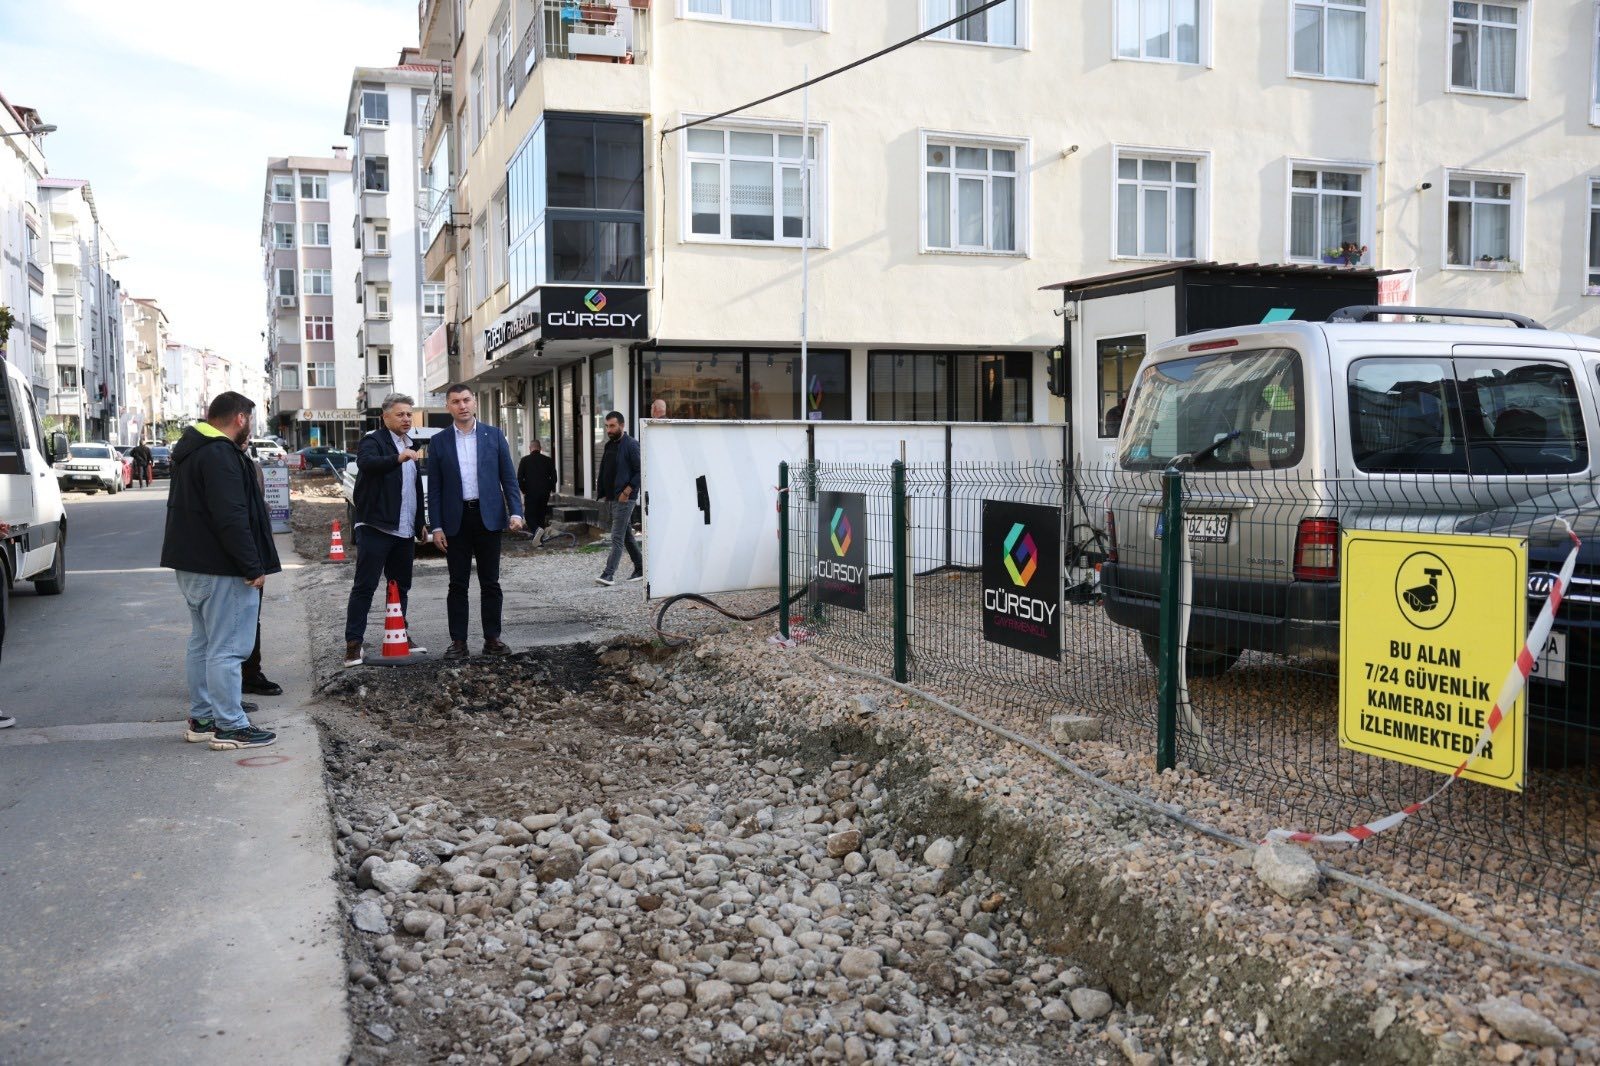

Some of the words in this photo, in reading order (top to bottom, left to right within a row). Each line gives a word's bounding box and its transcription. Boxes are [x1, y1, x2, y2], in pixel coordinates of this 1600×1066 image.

[547, 310, 642, 327] GÜRSOY
[1205, 516, 1228, 535] 439
[818, 560, 863, 584] GÜRSOY
[985, 588, 1057, 625] GÜRSOY
[1390, 640, 1411, 660] BU
[1417, 644, 1461, 668] ALAN
[1365, 662, 1399, 685] 7/24
[1404, 667, 1490, 701] GÜVENLİK
[1367, 689, 1452, 722] KAMERASI
[1458, 702, 1485, 729] İLE
